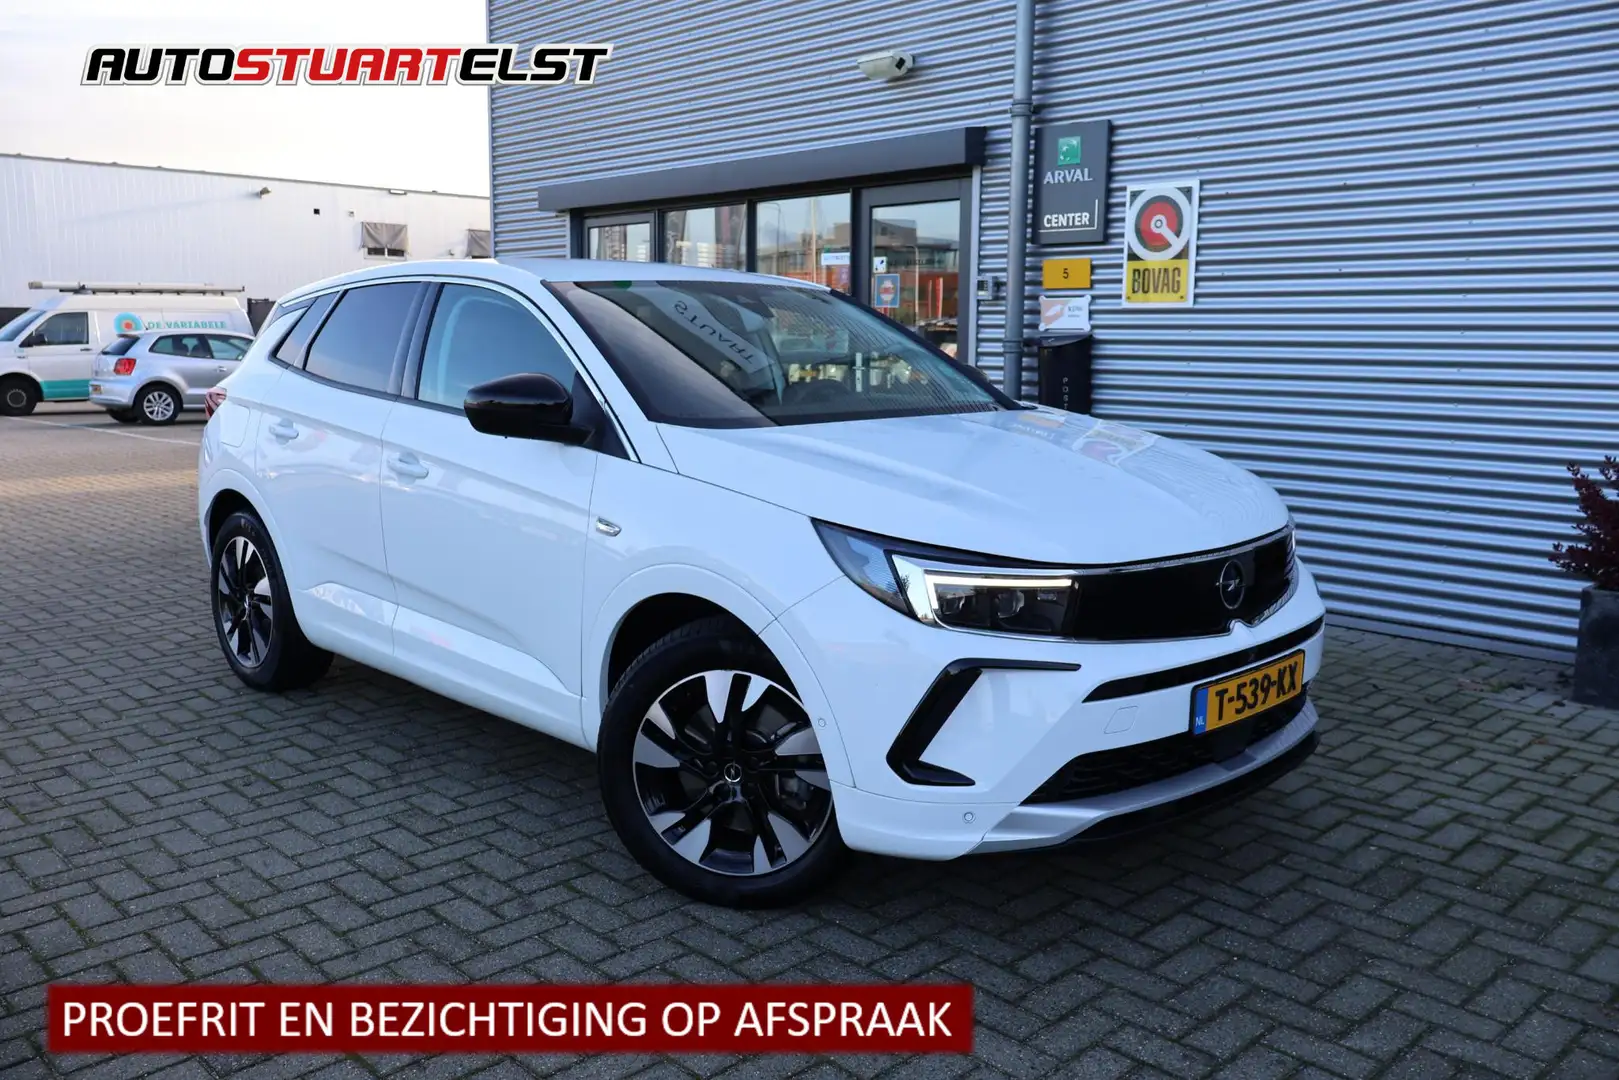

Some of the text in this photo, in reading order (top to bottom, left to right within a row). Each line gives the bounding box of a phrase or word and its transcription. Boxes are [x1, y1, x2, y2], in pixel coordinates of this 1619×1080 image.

[1043, 167, 1093, 185] ARVAL
[1043, 212, 1090, 228] CENTER
[1062, 268, 1070, 280] 5
[1131, 267, 1181, 294] BOVAG
[147, 320, 228, 329] DE VARIABELE
[1195, 660, 1299, 727] NL T-539-KX
